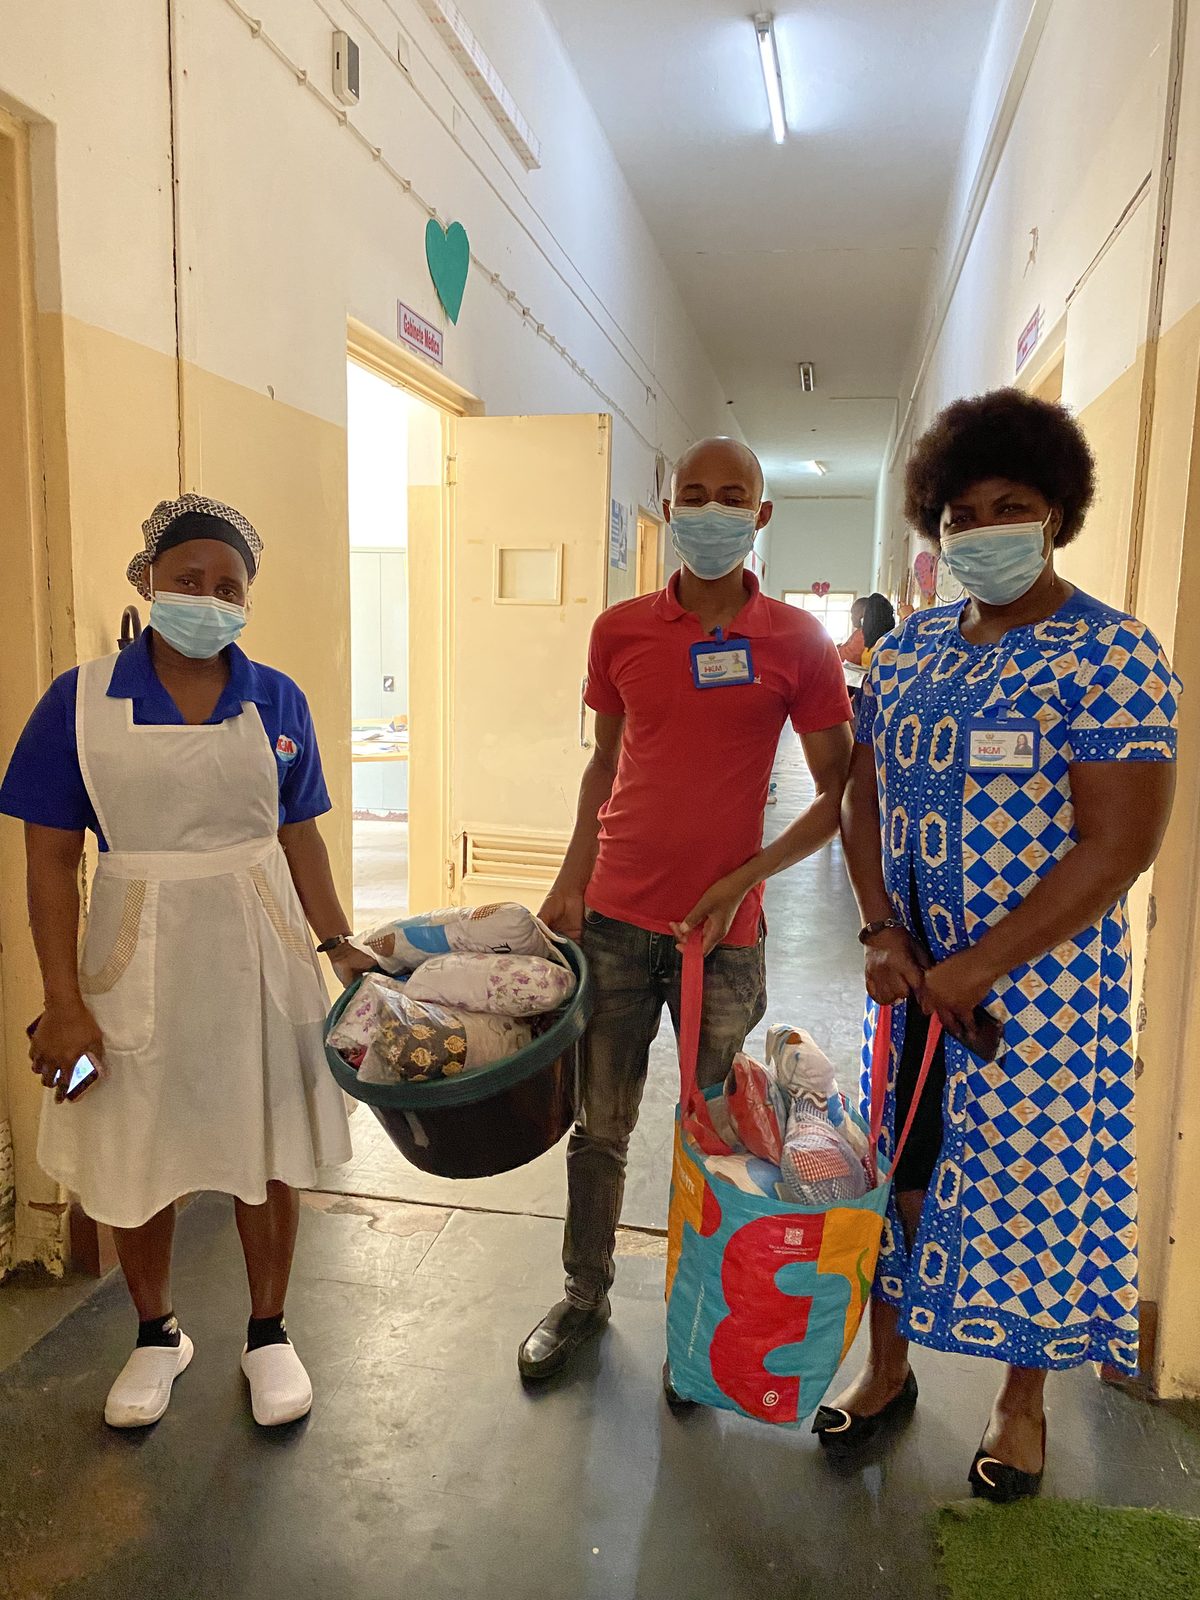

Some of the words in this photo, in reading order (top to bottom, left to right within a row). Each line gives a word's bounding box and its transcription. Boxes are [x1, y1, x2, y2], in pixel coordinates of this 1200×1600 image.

[403, 313, 424, 344] Gabinete
[424, 328, 440, 356] Médico
[978, 746, 1001, 755] HGM
